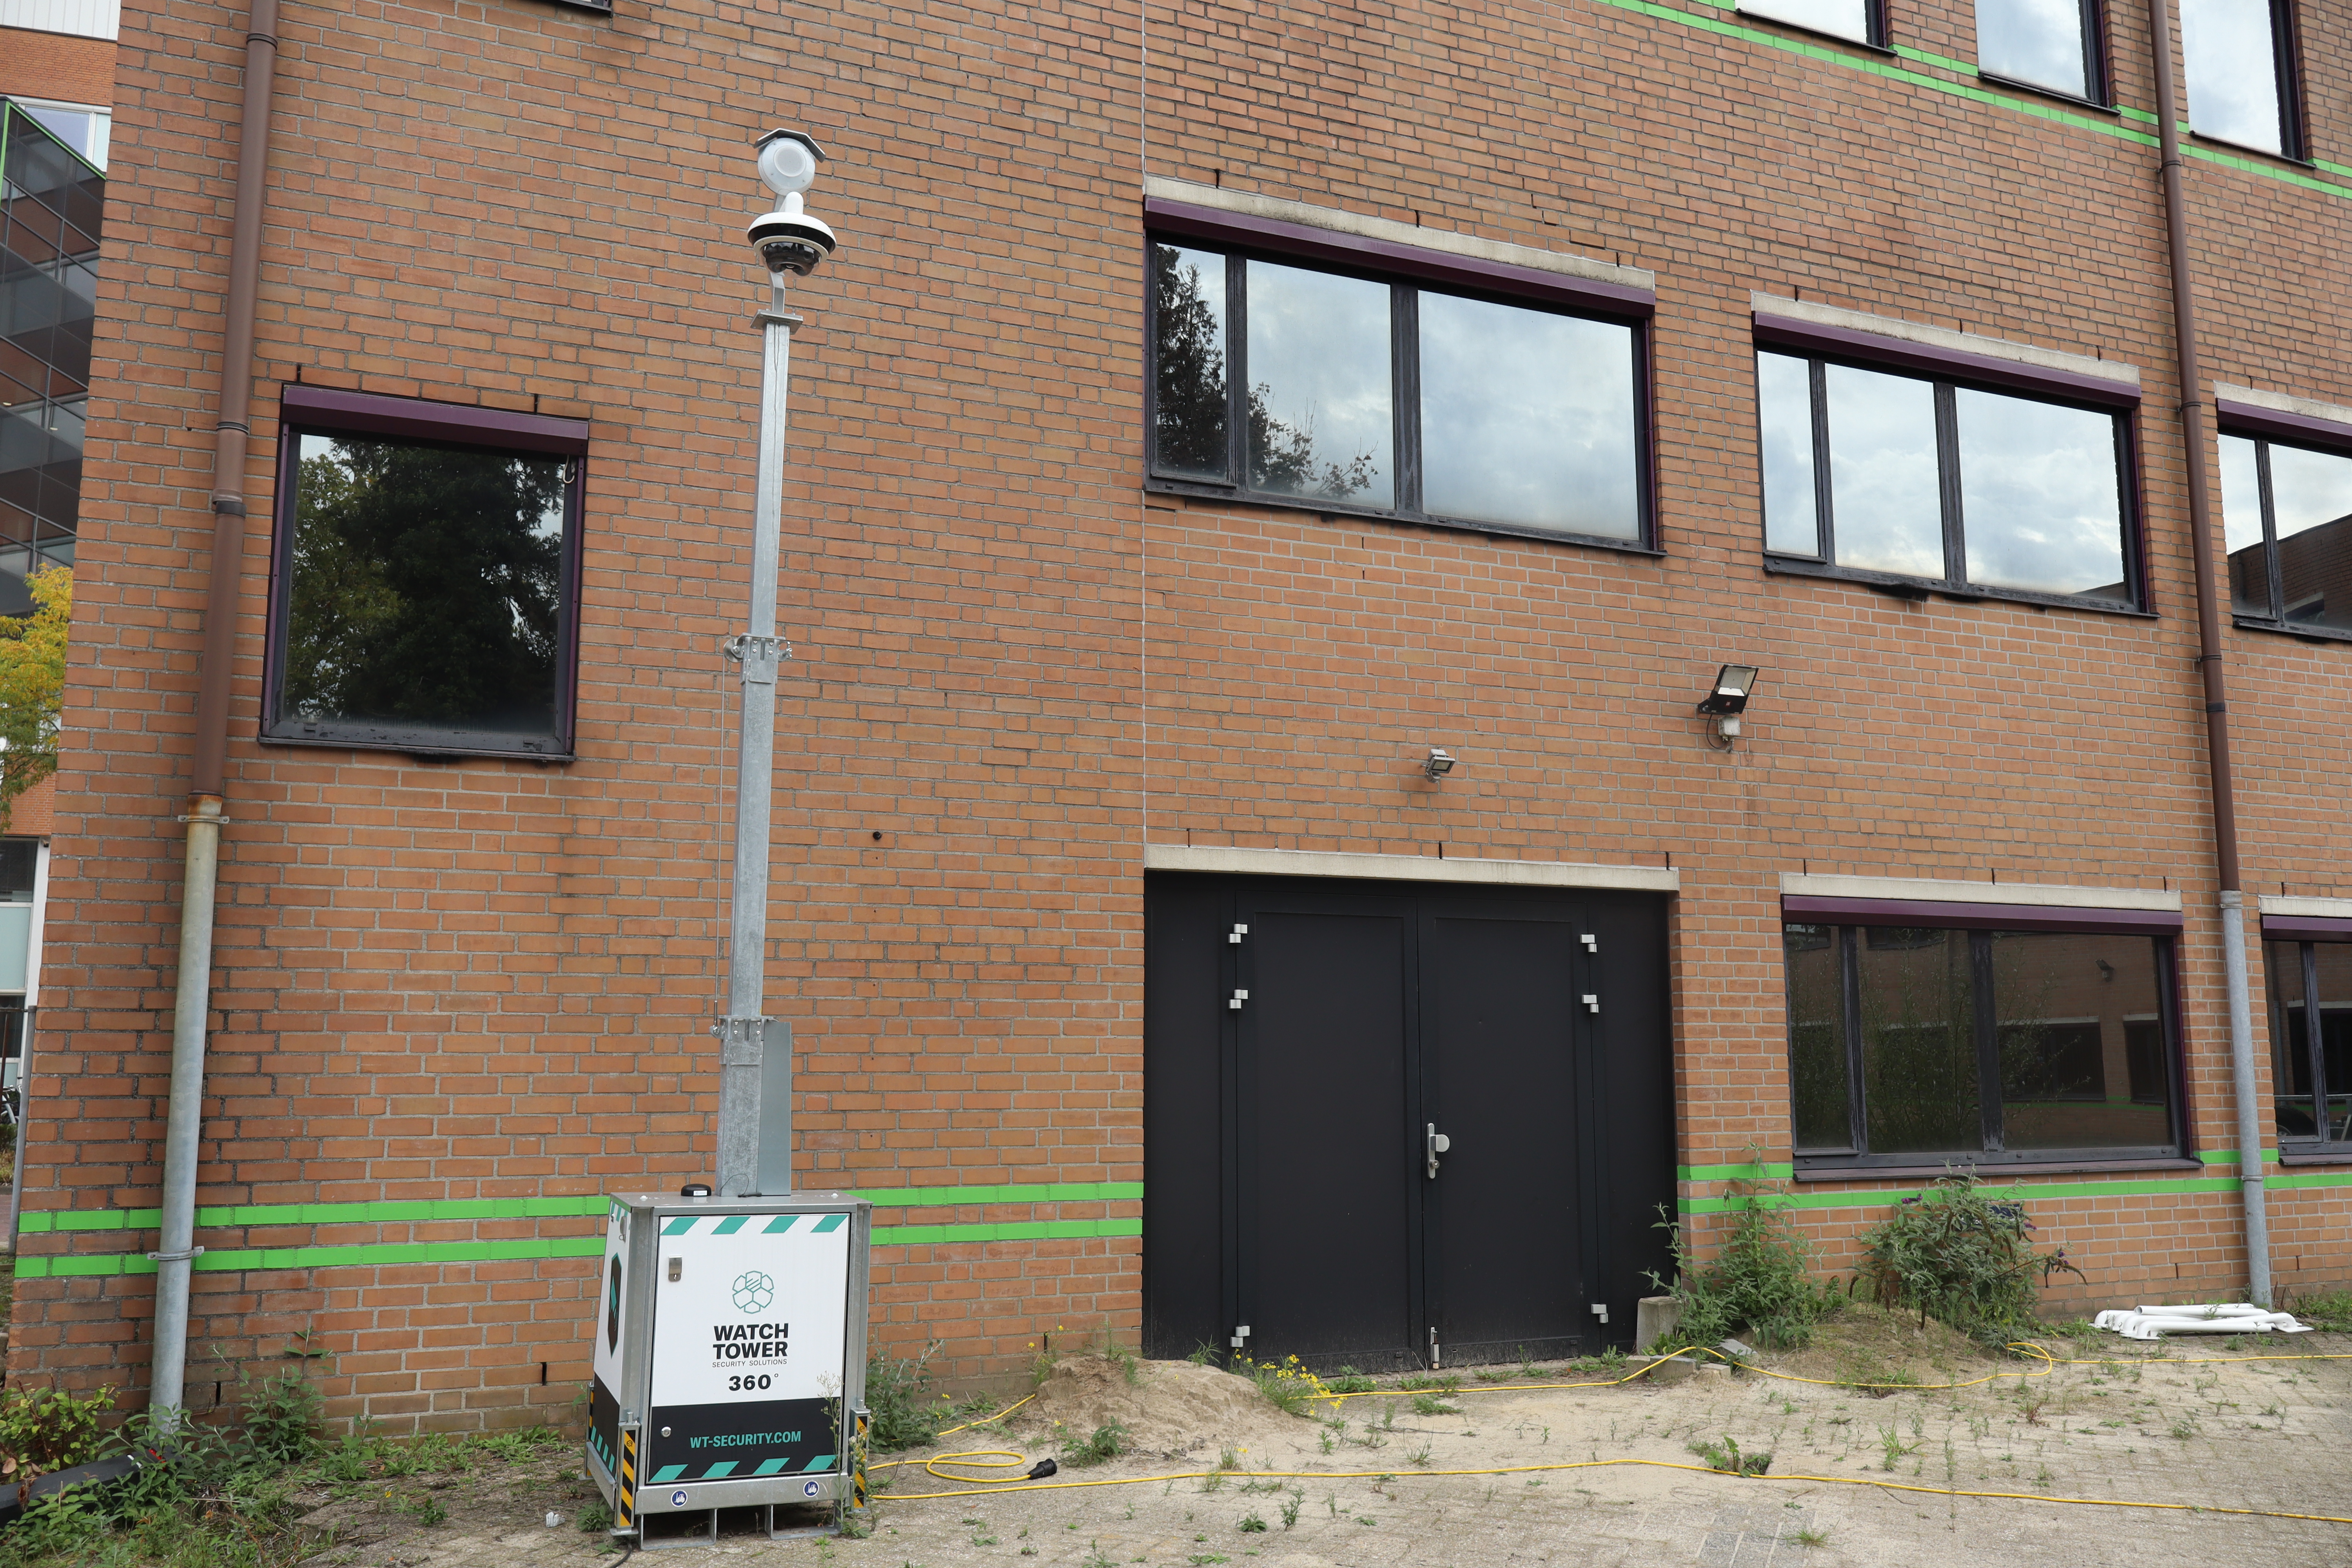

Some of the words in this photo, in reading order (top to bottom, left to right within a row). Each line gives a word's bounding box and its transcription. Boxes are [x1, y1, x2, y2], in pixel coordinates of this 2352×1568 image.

[714, 1323, 789, 1341] WATCH
[713, 1341, 788, 1359] TOWER
[690, 1431, 801, 1448] WT-SECURITY.COM
